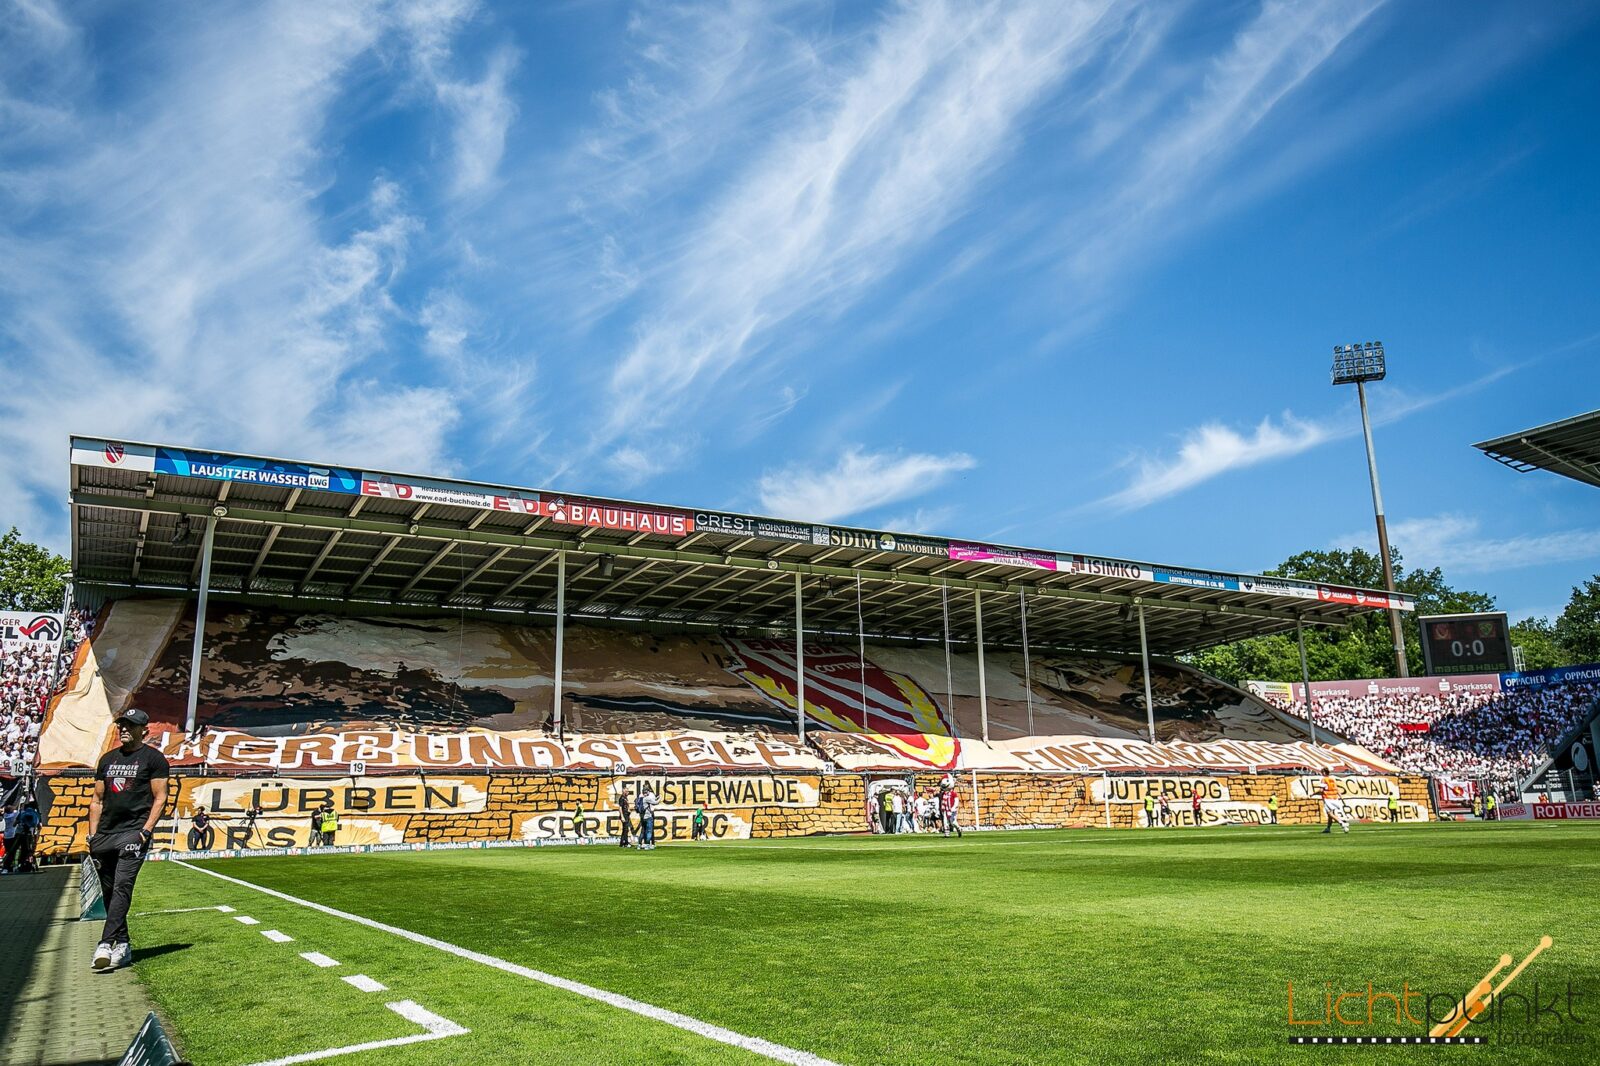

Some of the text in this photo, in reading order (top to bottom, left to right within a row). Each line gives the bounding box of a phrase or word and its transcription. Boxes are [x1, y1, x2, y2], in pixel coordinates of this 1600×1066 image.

[191, 464, 328, 487] LAUSITZER WASSER LWG
[362, 476, 413, 500] EAD
[415, 494, 491, 508] www.ead-buchholz.de
[493, 492, 538, 514] EAD
[571, 505, 685, 533] BAUHAUS
[695, 513, 755, 531] CREST
[695, 525, 755, 537] UNTERNEHMENSGRUPPE
[758, 522, 810, 536] WOHNTRÄUME
[830, 529, 878, 550] SDIM
[896, 543, 949, 556] IMMOBILIEN
[993, 556, 1012, 565] DIANA
[1087, 559, 1141, 579] ISIMKO
[1253, 578, 1290, 590] Wernecke
[1451, 640, 1485, 657] 0:0
[1452, 682, 1493, 692] Sparkasse
[1505, 675, 1546, 687] OPPACHER
[1312, 688, 1350, 698] Sparkasse
[1381, 686, 1421, 696] Sparkasse
[414, 735, 565, 767] UND
[578, 736, 805, 769] SEELE
[14, 762, 24, 773] 18
[353, 762, 364, 773] 19
[615, 763, 626, 773] 20
[825, 764, 833, 772] 21
[621, 780, 799, 805] FINSTERWALDE
[1103, 779, 1222, 800] JÜTERBOG
[1299, 779, 1390, 796] VESCHAU
[211, 782, 459, 813] LÜBBEN
[1535, 805, 1564, 818] ROT
[125, 843, 141, 851] CDW
